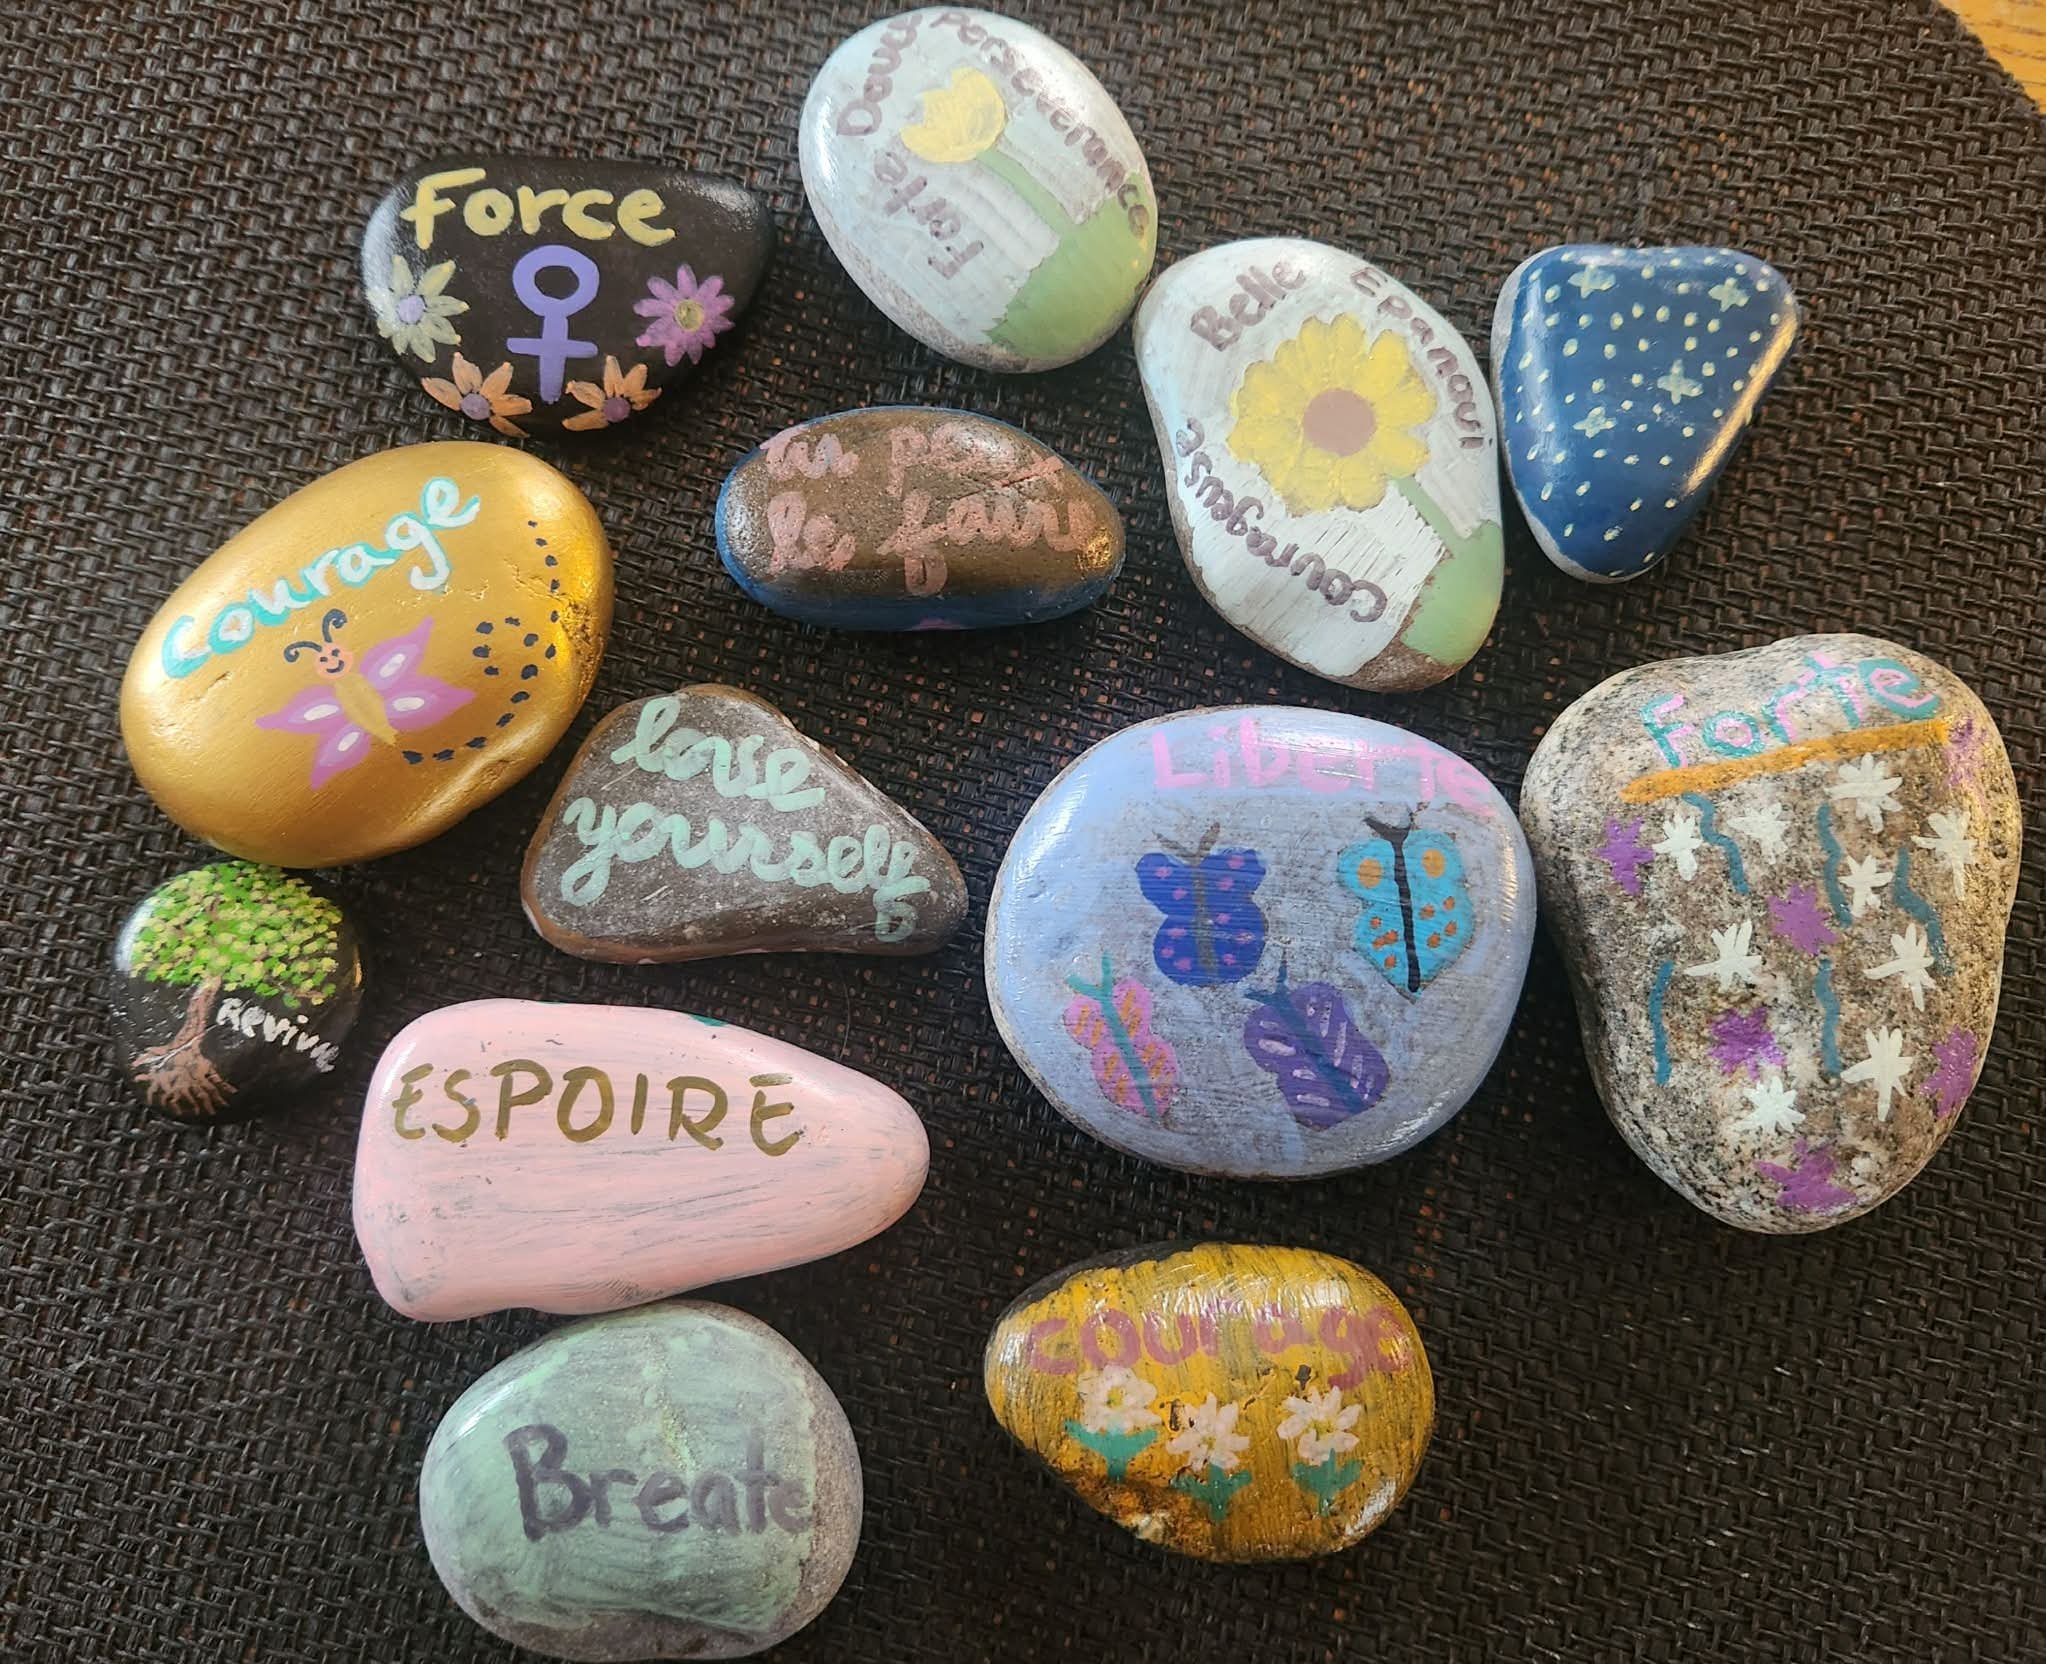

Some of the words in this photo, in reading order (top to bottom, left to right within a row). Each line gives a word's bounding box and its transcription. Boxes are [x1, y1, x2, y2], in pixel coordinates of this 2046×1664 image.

[1190, 260, 1305, 352] Belle
[611, 694, 827, 812] love
[560, 797, 931, 943] yourself
[391, 1058, 803, 1157] ESPOIRE
